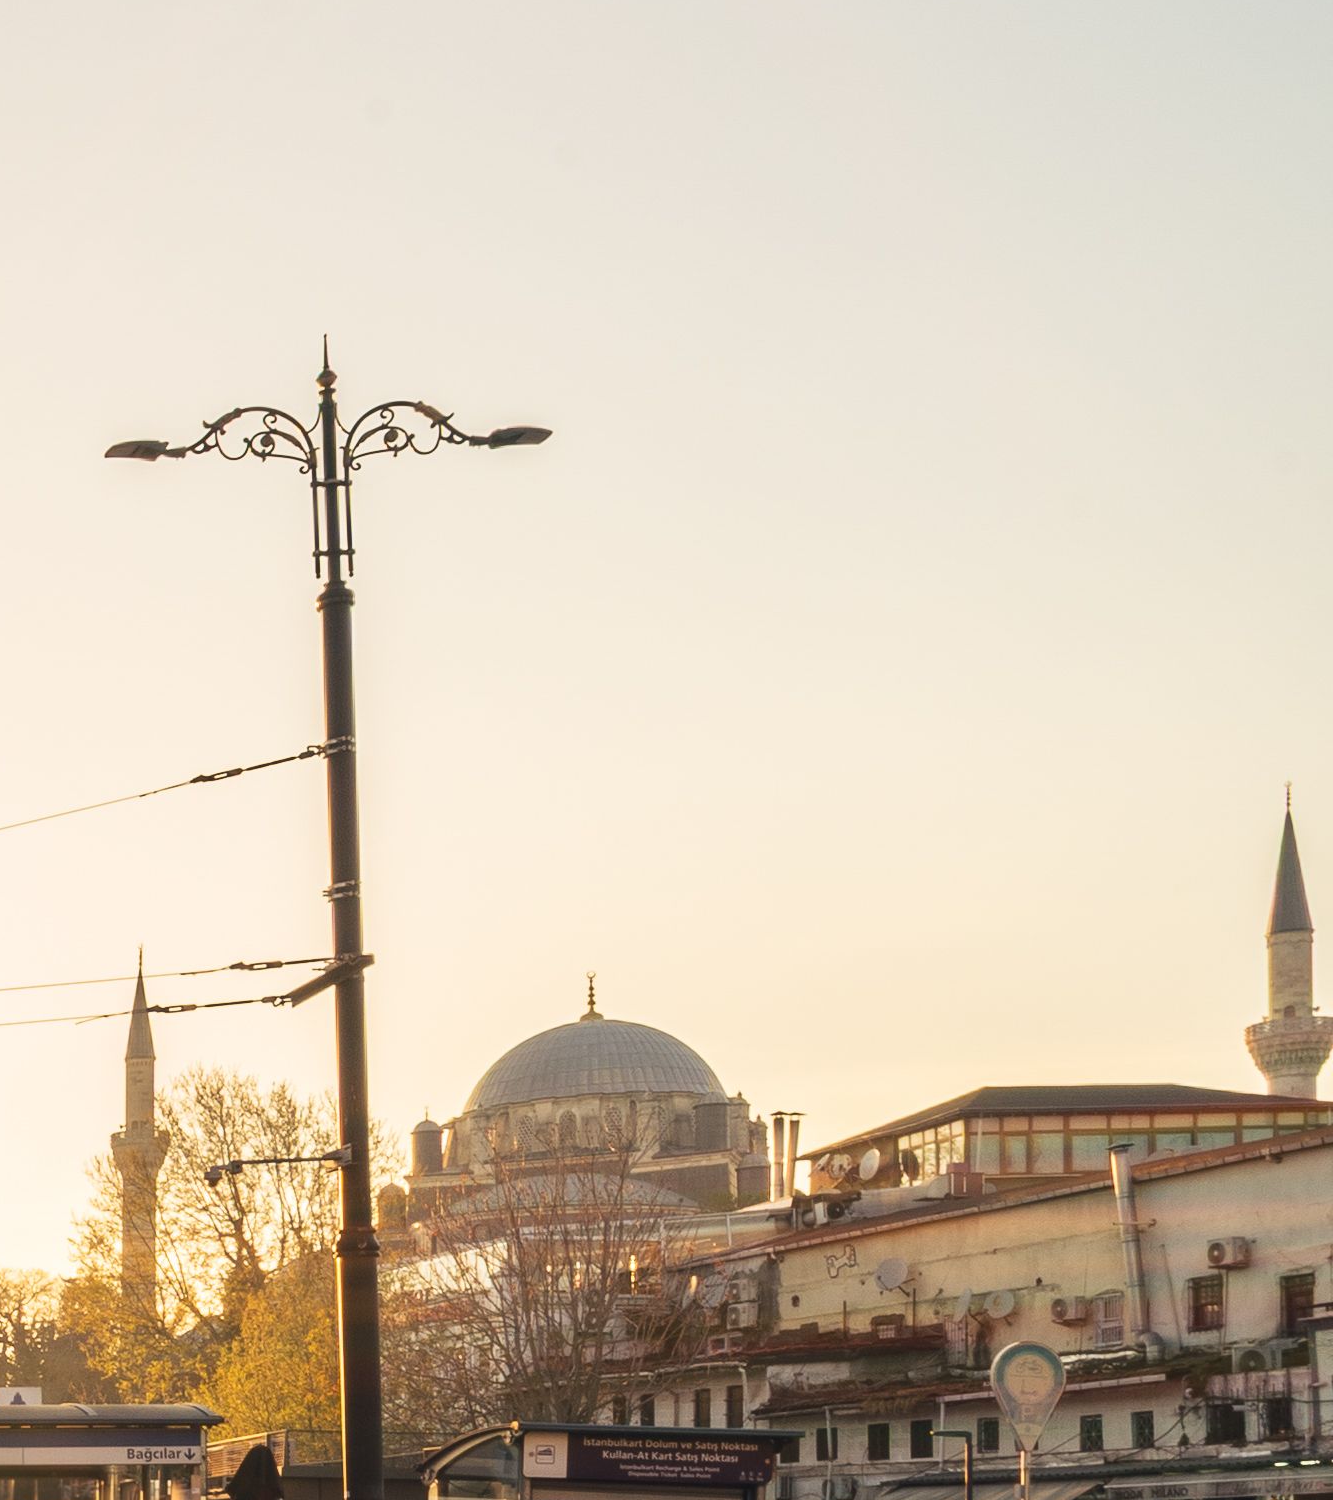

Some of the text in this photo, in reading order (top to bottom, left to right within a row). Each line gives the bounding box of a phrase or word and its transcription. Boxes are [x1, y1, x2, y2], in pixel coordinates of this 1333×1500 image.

[583, 1437, 643, 1448] İstanbulkart
[645, 1440, 678, 1449] Dolum
[695, 1441, 718, 1452] Satış
[721, 1442, 758, 1451] Noktası
[127, 1448, 181, 1462] Bağcılar
[602, 1450, 738, 1463] Kullan-At Kart Satış Noktası
